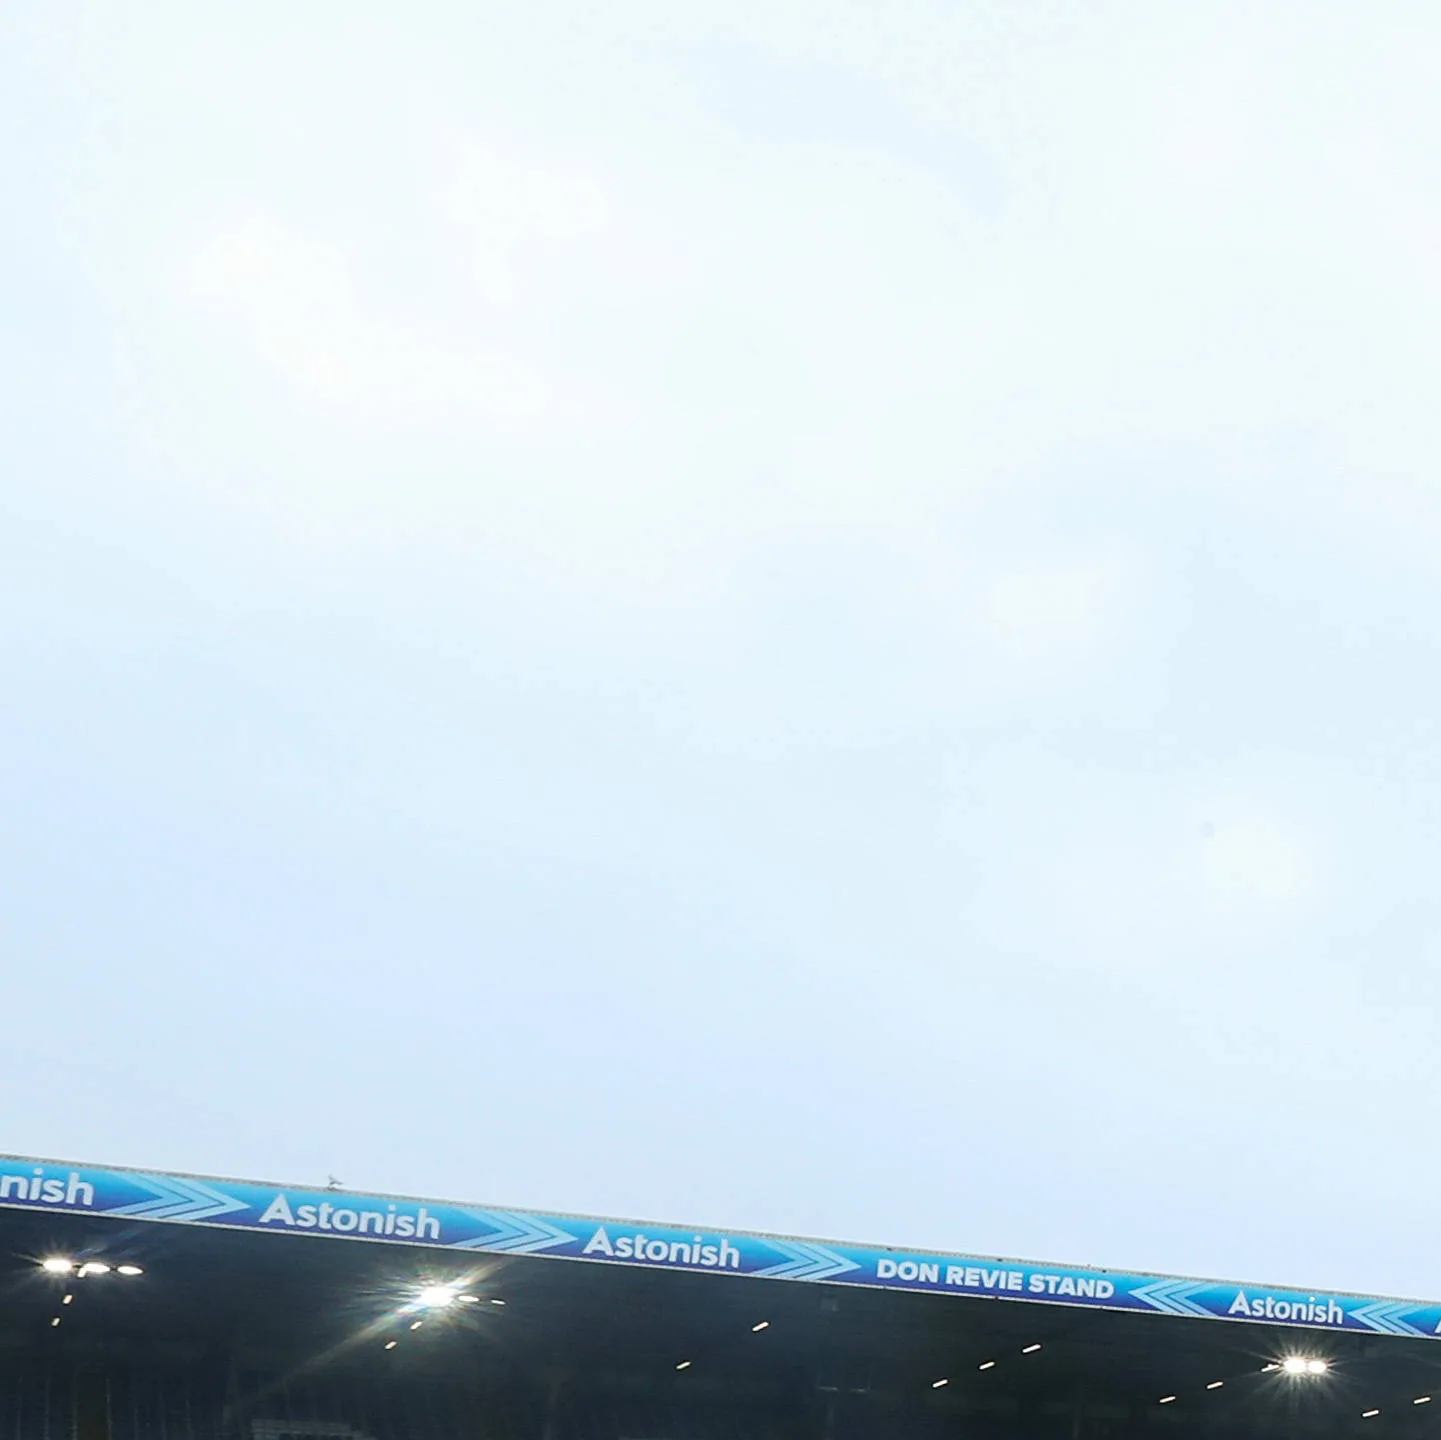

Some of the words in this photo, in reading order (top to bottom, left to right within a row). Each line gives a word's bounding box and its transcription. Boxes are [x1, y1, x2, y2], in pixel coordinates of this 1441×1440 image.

[258, 1193, 440, 1240] Astonish
[582, 1226, 740, 1269] Astonish
[876, 1258, 940, 1284] DON
[945, 1265, 1023, 1291] REVIE
[1028, 1272, 1115, 1299] STAND
[1228, 1289, 1343, 1325] Astonish
